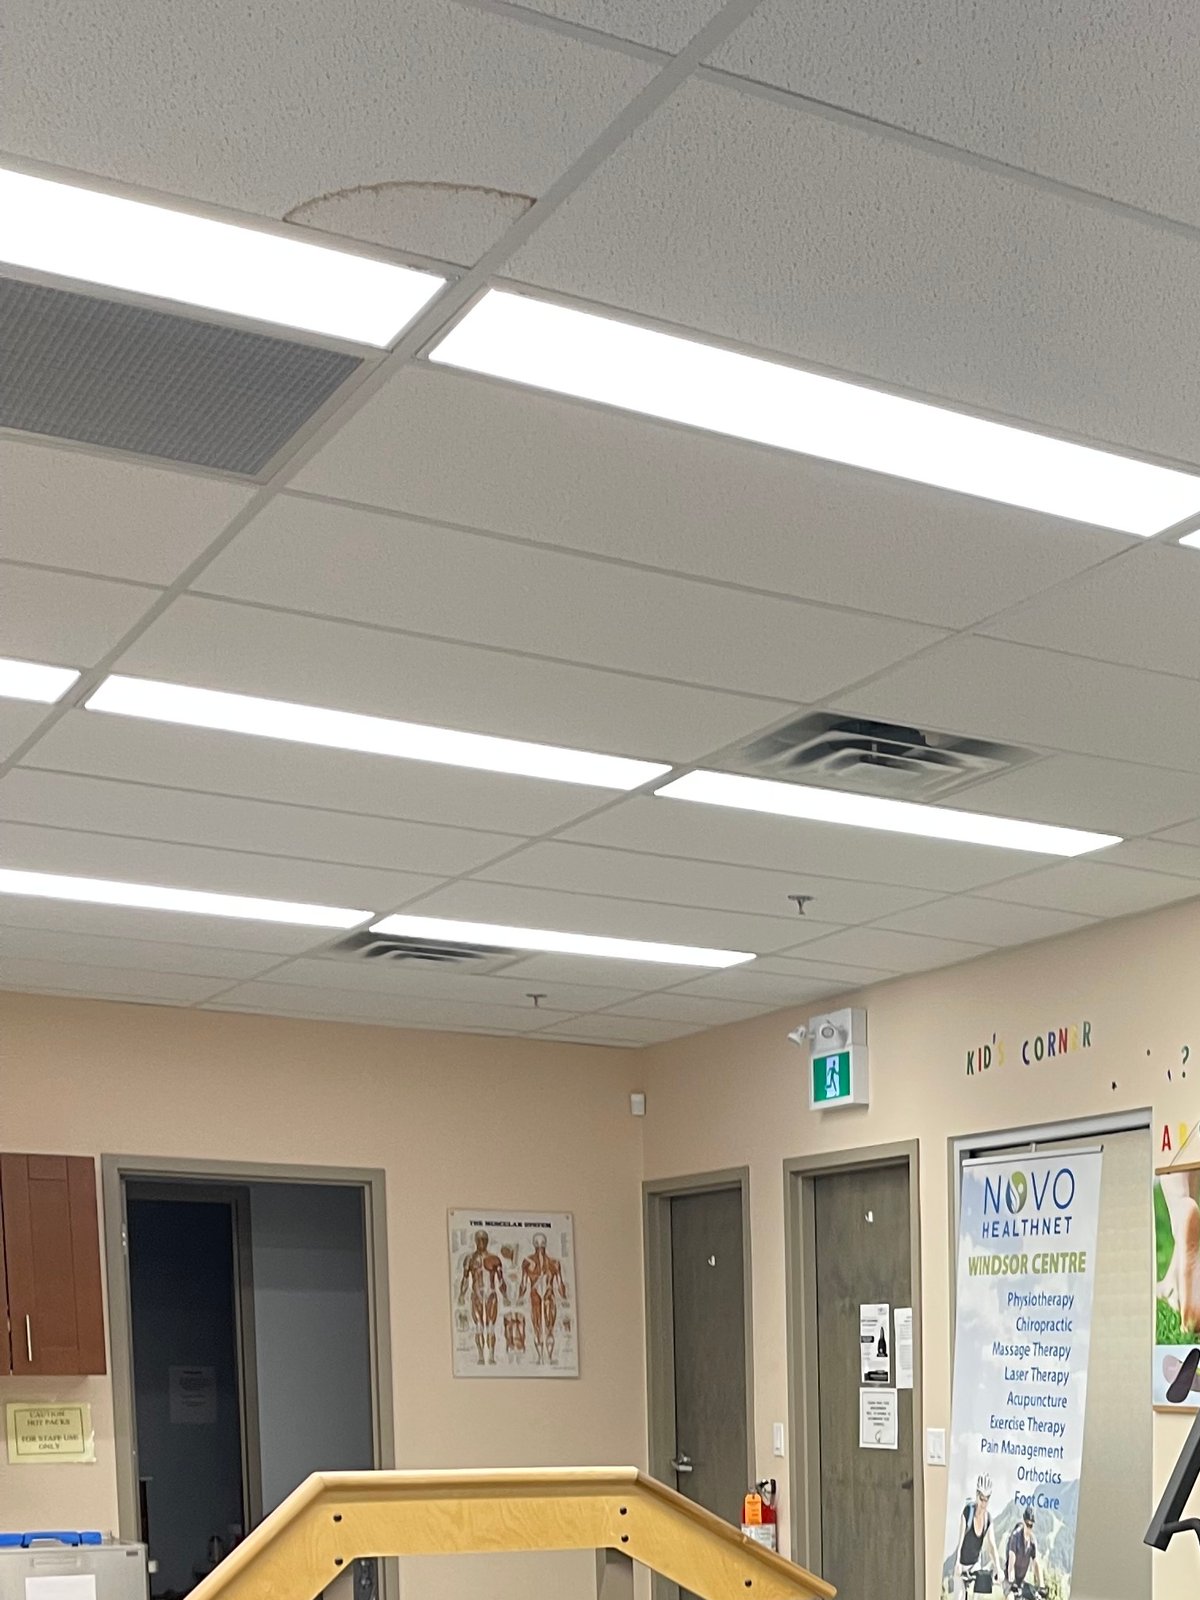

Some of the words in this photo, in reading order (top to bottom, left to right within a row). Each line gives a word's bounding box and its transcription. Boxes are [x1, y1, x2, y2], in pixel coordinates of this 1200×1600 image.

[966, 1032, 1006, 1076] KID'S
[1022, 1020, 1092, 1066] CORNER
[984, 1168, 1075, 1215] NOVO
[982, 1216, 1073, 1239] HEALTHNET
[968, 1253, 1029, 1277] WINDSOR
[1031, 1251, 1087, 1275] CENTRE
[1007, 1291, 1074, 1311] Physiotherapy
[1016, 1316, 1073, 1335] Chiropractic
[992, 1341, 1031, 1360] Massage
[1032, 1341, 1071, 1362] Therapy
[1004, 1365, 1029, 1381] Laser
[1030, 1366, 1070, 1387] Therapy
[1006, 1390, 1068, 1409] Acupuncture
[990, 1414, 1025, 1431] Exercise
[1027, 1416, 1066, 1438] Therapy
[981, 1438, 999, 1454] Pain
[1001, 1439, 1064, 1460] Management
[1017, 1465, 1062, 1485] Orthotics
[1014, 1490, 1036, 1507] Foot
[1037, 1492, 1060, 1510] Care
